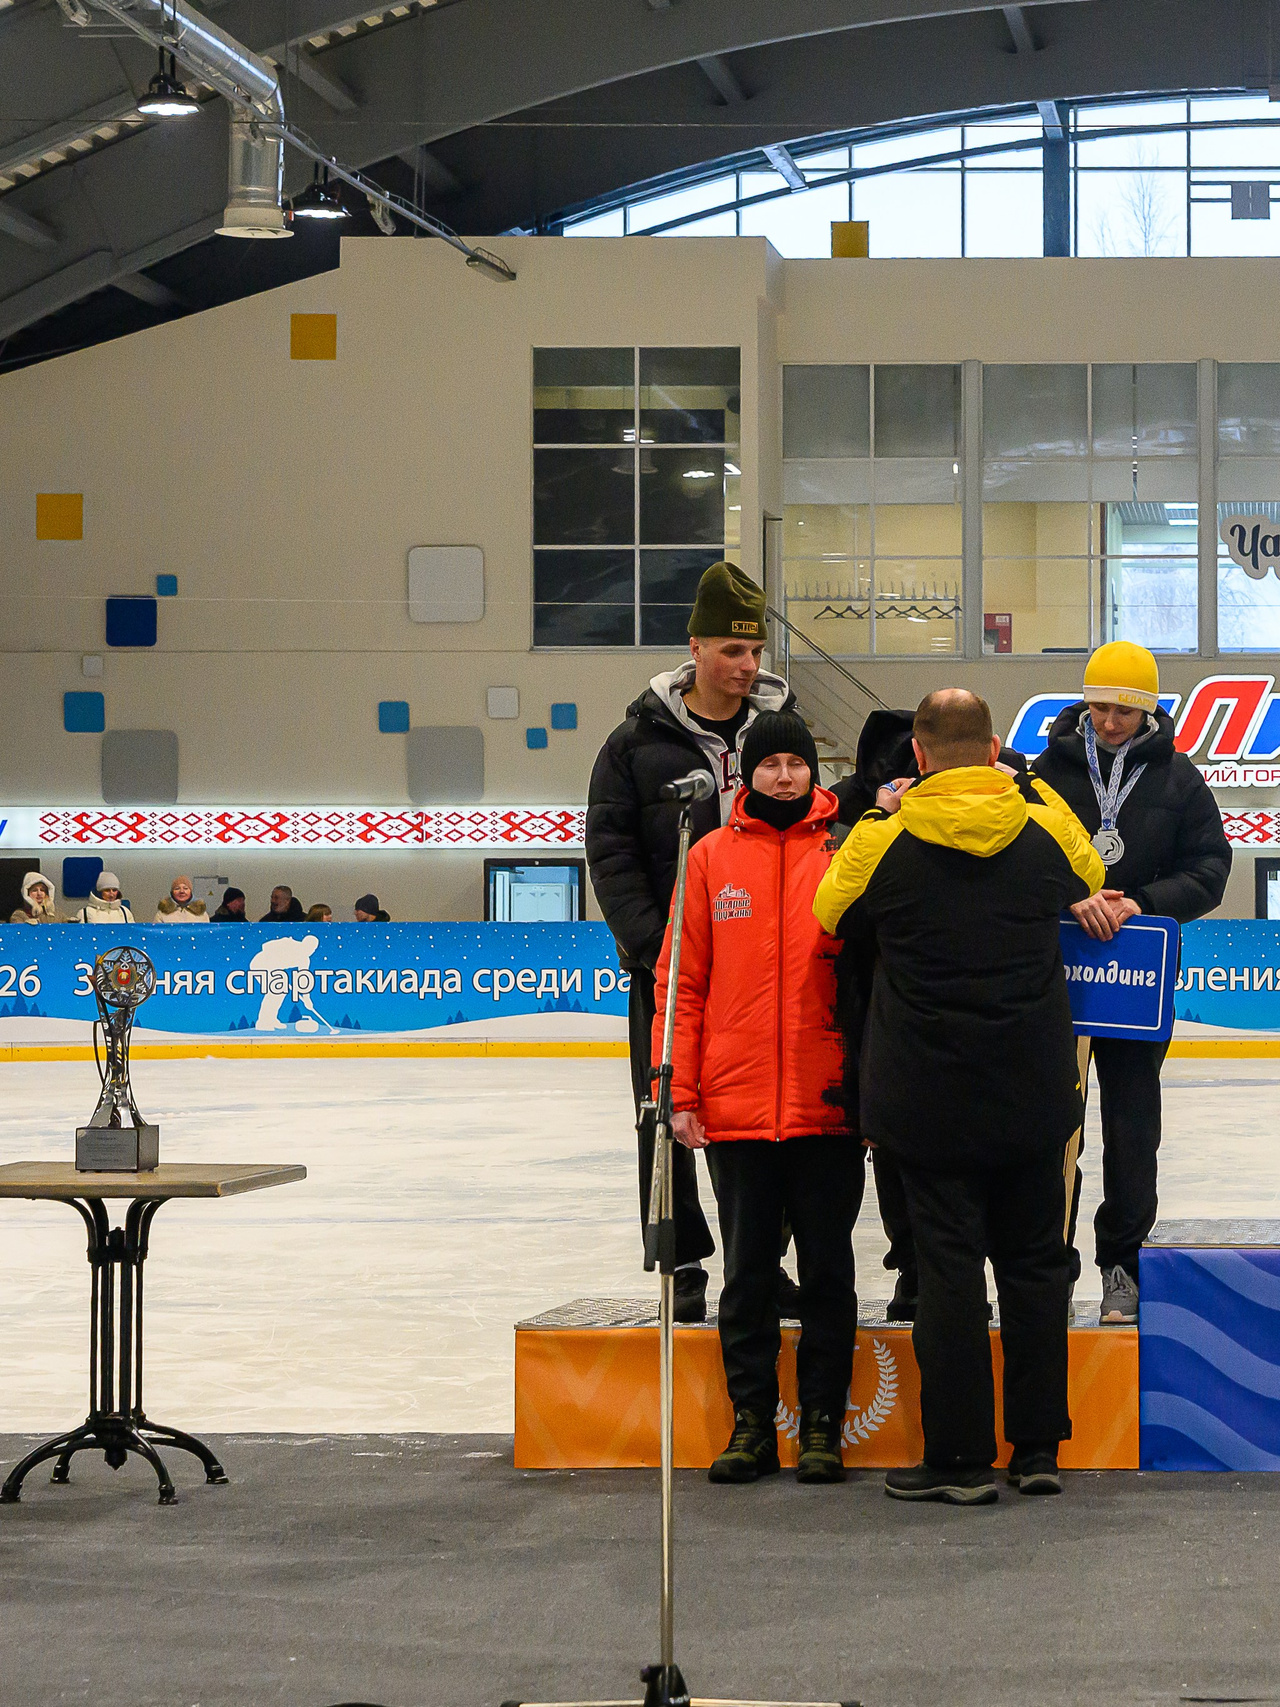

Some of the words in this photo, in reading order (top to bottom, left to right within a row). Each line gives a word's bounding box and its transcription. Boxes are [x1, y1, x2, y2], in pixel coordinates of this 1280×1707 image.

[72, 963, 215, 996] Зняя
[225, 969, 462, 1002] спартакиада
[472, 968, 582, 1001] среди
